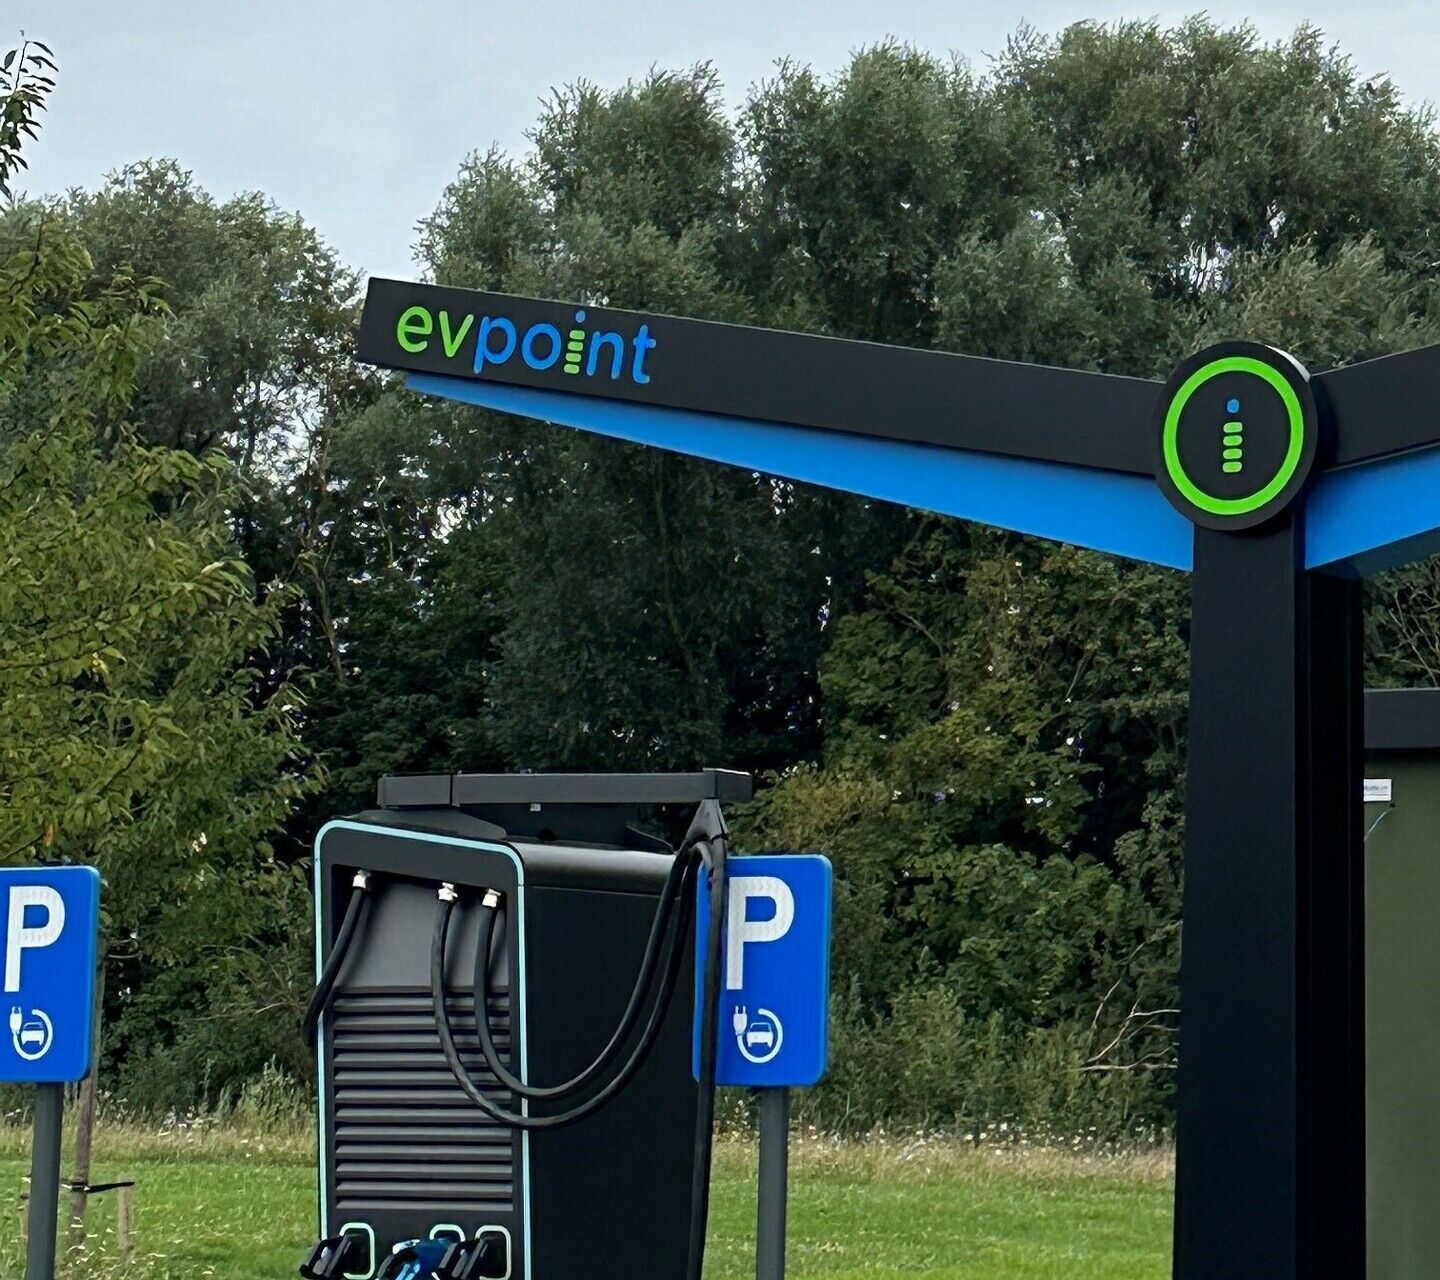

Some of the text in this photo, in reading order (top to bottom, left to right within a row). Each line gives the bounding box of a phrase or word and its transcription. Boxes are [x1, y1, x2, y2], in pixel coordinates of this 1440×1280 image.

[397, 305, 656, 384] evpoint
[4, 886, 65, 992] P
[726, 876, 795, 990] P
